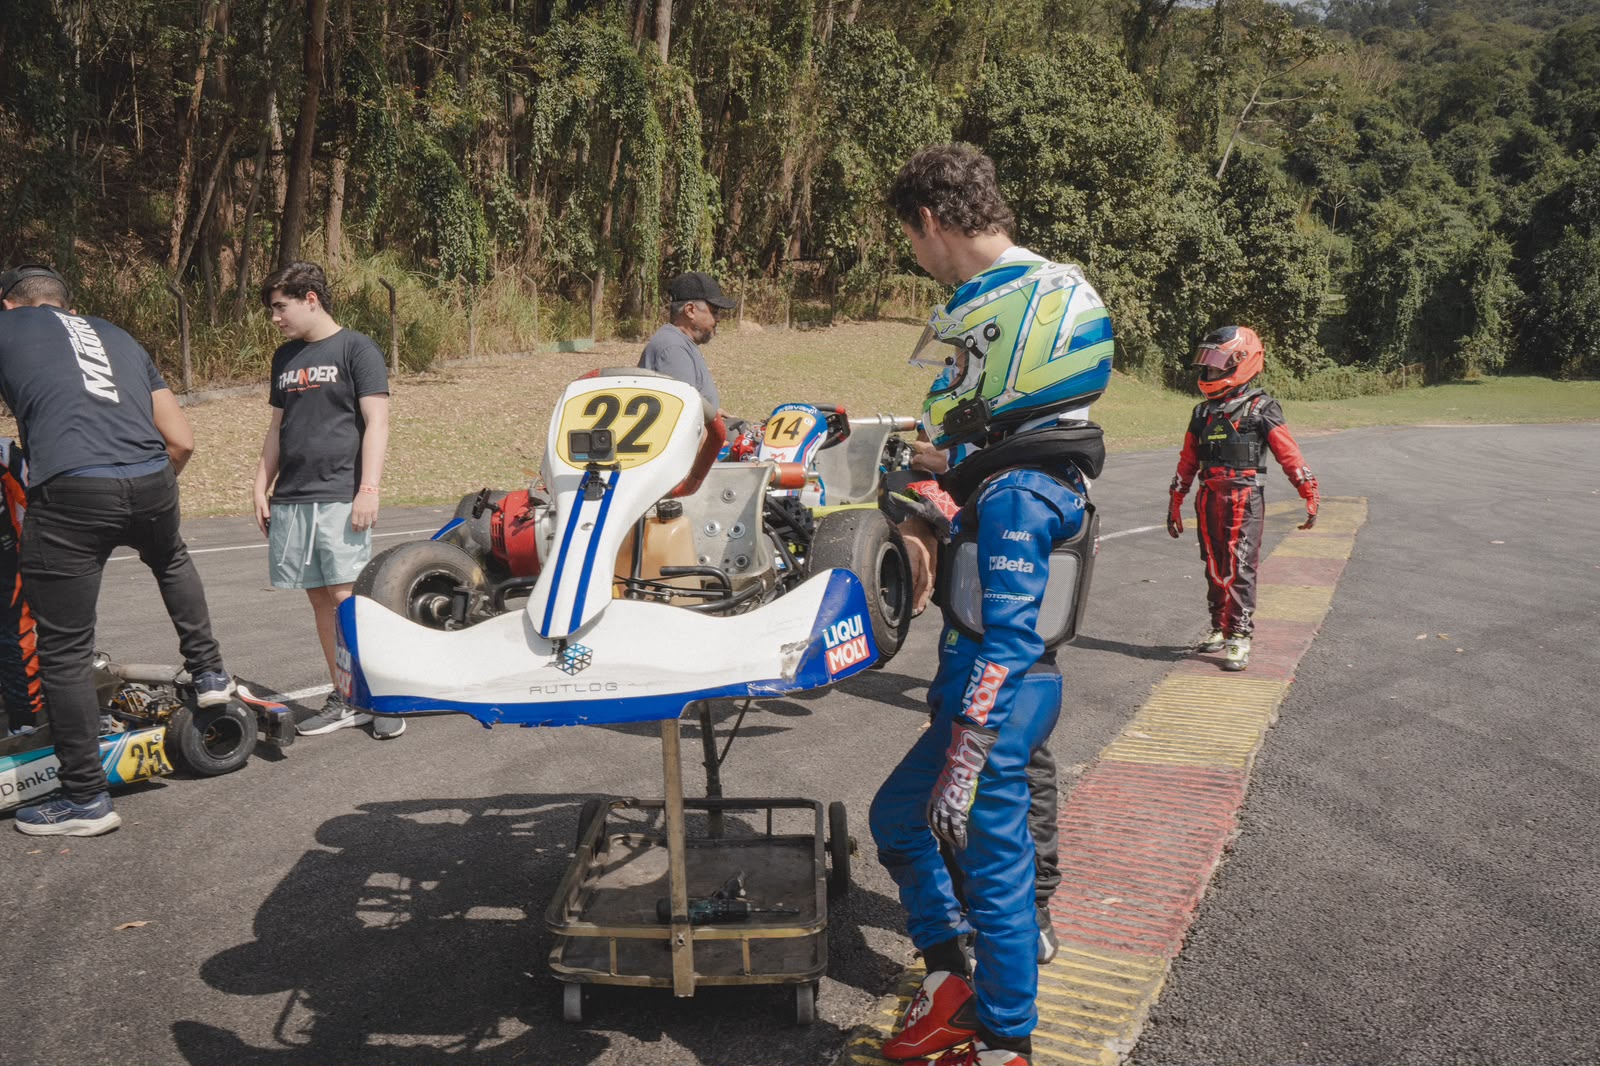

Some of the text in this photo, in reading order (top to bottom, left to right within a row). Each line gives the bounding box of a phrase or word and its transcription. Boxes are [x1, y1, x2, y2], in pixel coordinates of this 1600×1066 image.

[279, 365, 338, 390] THUNDER
[581, 394, 662, 453] 22
[766, 416, 803, 441] 14
[1002, 529, 1033, 542] Logix
[996, 555, 1034, 574] Beta
[822, 615, 864, 649] LIQUI
[828, 636, 867, 671] MOLY
[529, 682, 619, 695] AUTLOG
[961, 656, 986, 715] IQUI
[967, 664, 1003, 722] MOLY
[131, 741, 163, 781] 25
